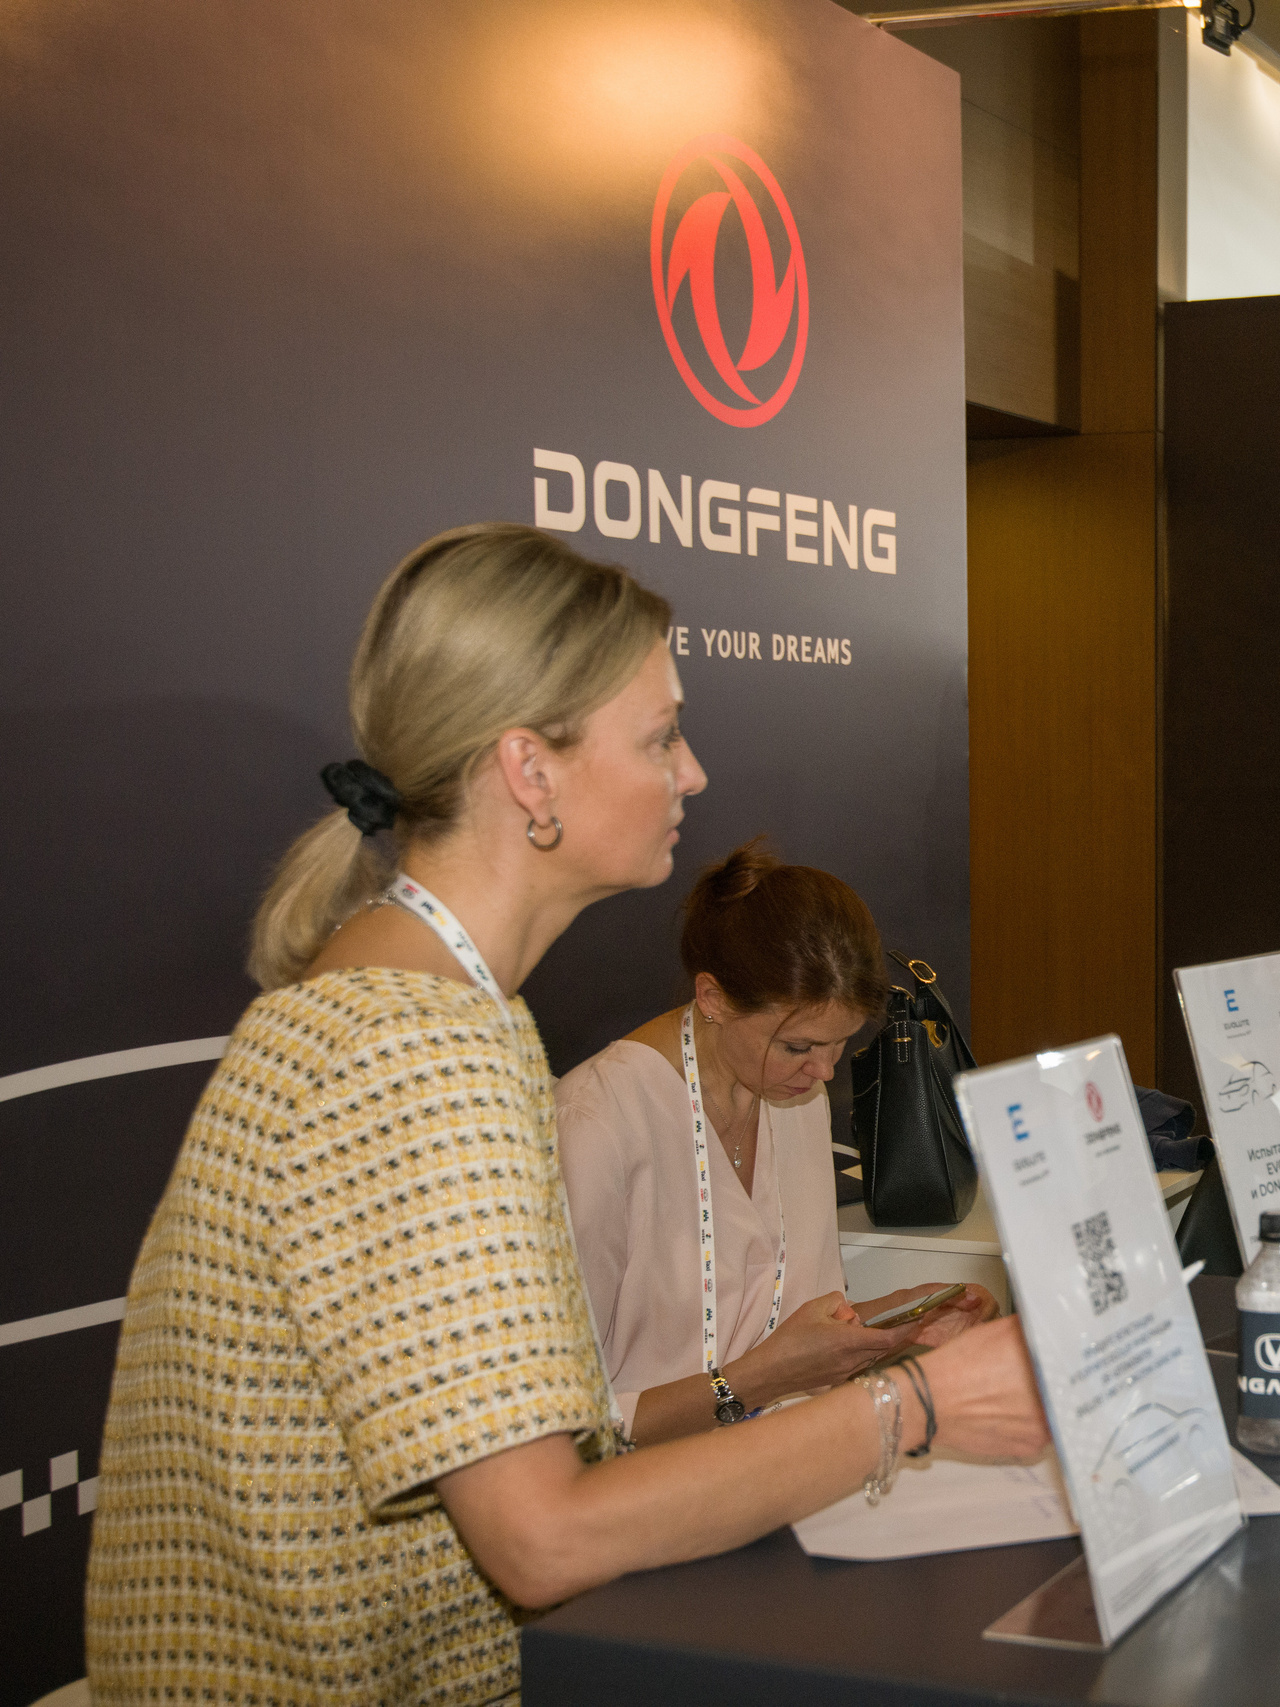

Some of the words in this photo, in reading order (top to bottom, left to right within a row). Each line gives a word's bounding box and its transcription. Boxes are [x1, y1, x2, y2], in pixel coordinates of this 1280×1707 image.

[534, 448, 896, 575] DONGFENG
[700, 628, 763, 661] YOUR
[772, 634, 852, 666] DREAMS
[1250, 1189, 1259, 1199] и
